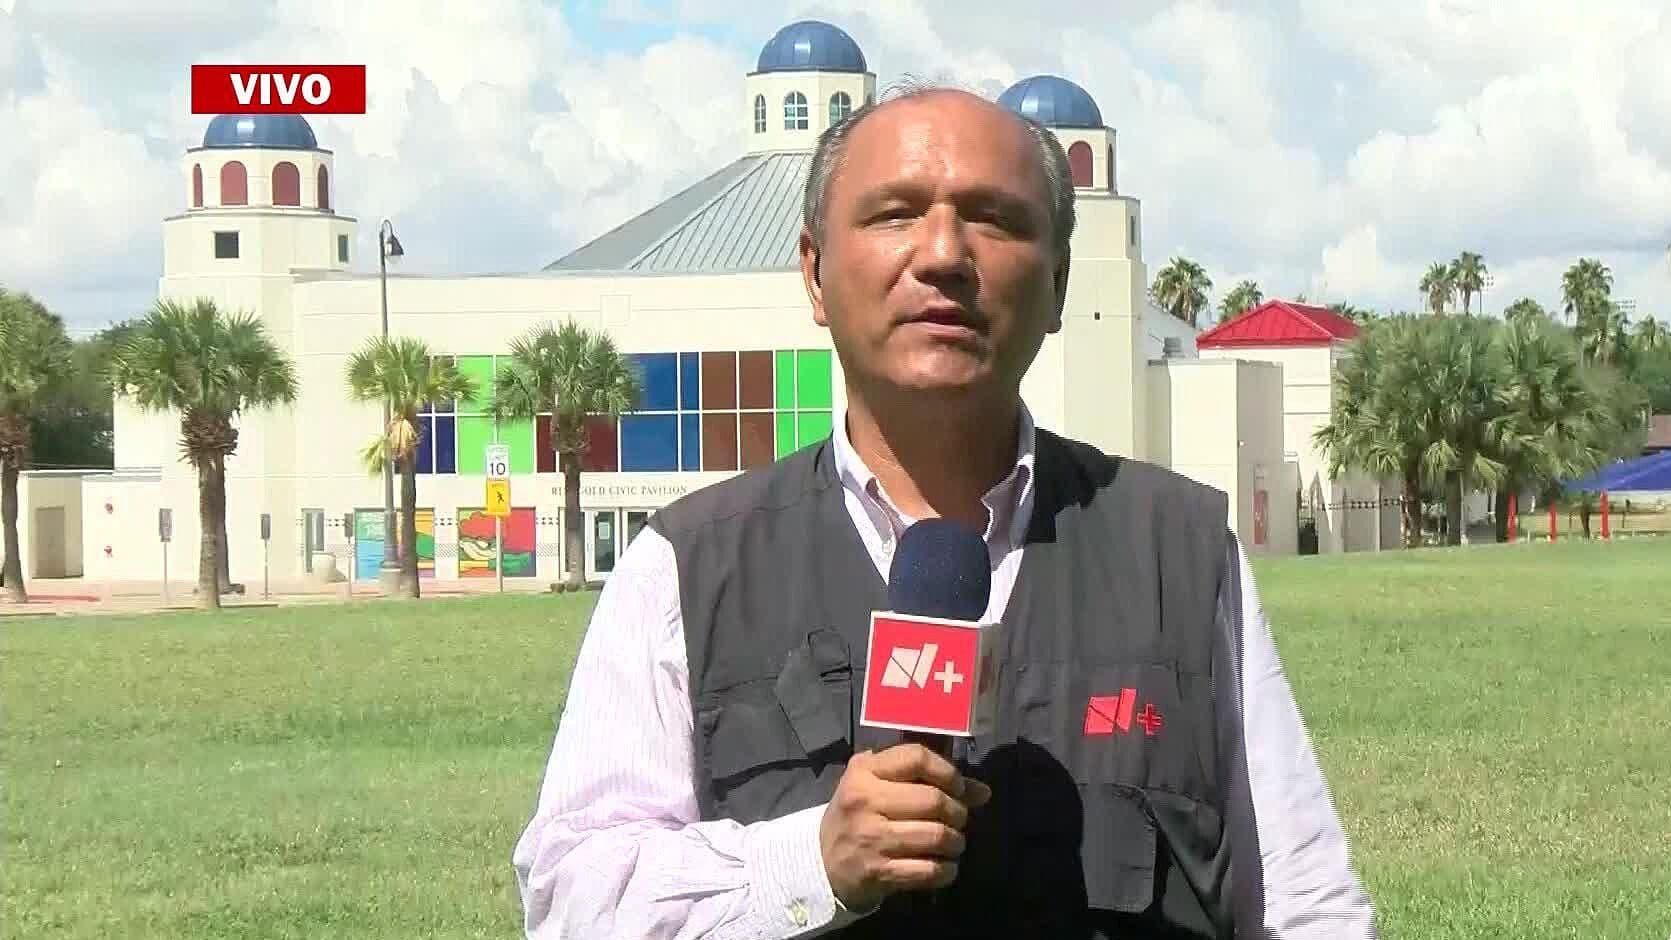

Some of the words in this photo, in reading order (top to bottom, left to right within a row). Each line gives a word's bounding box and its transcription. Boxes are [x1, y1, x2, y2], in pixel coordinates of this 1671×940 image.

[489, 462, 506, 476] 10
[551, 486, 605, 497] RIOLD
[608, 486, 639, 497] CIVIC
